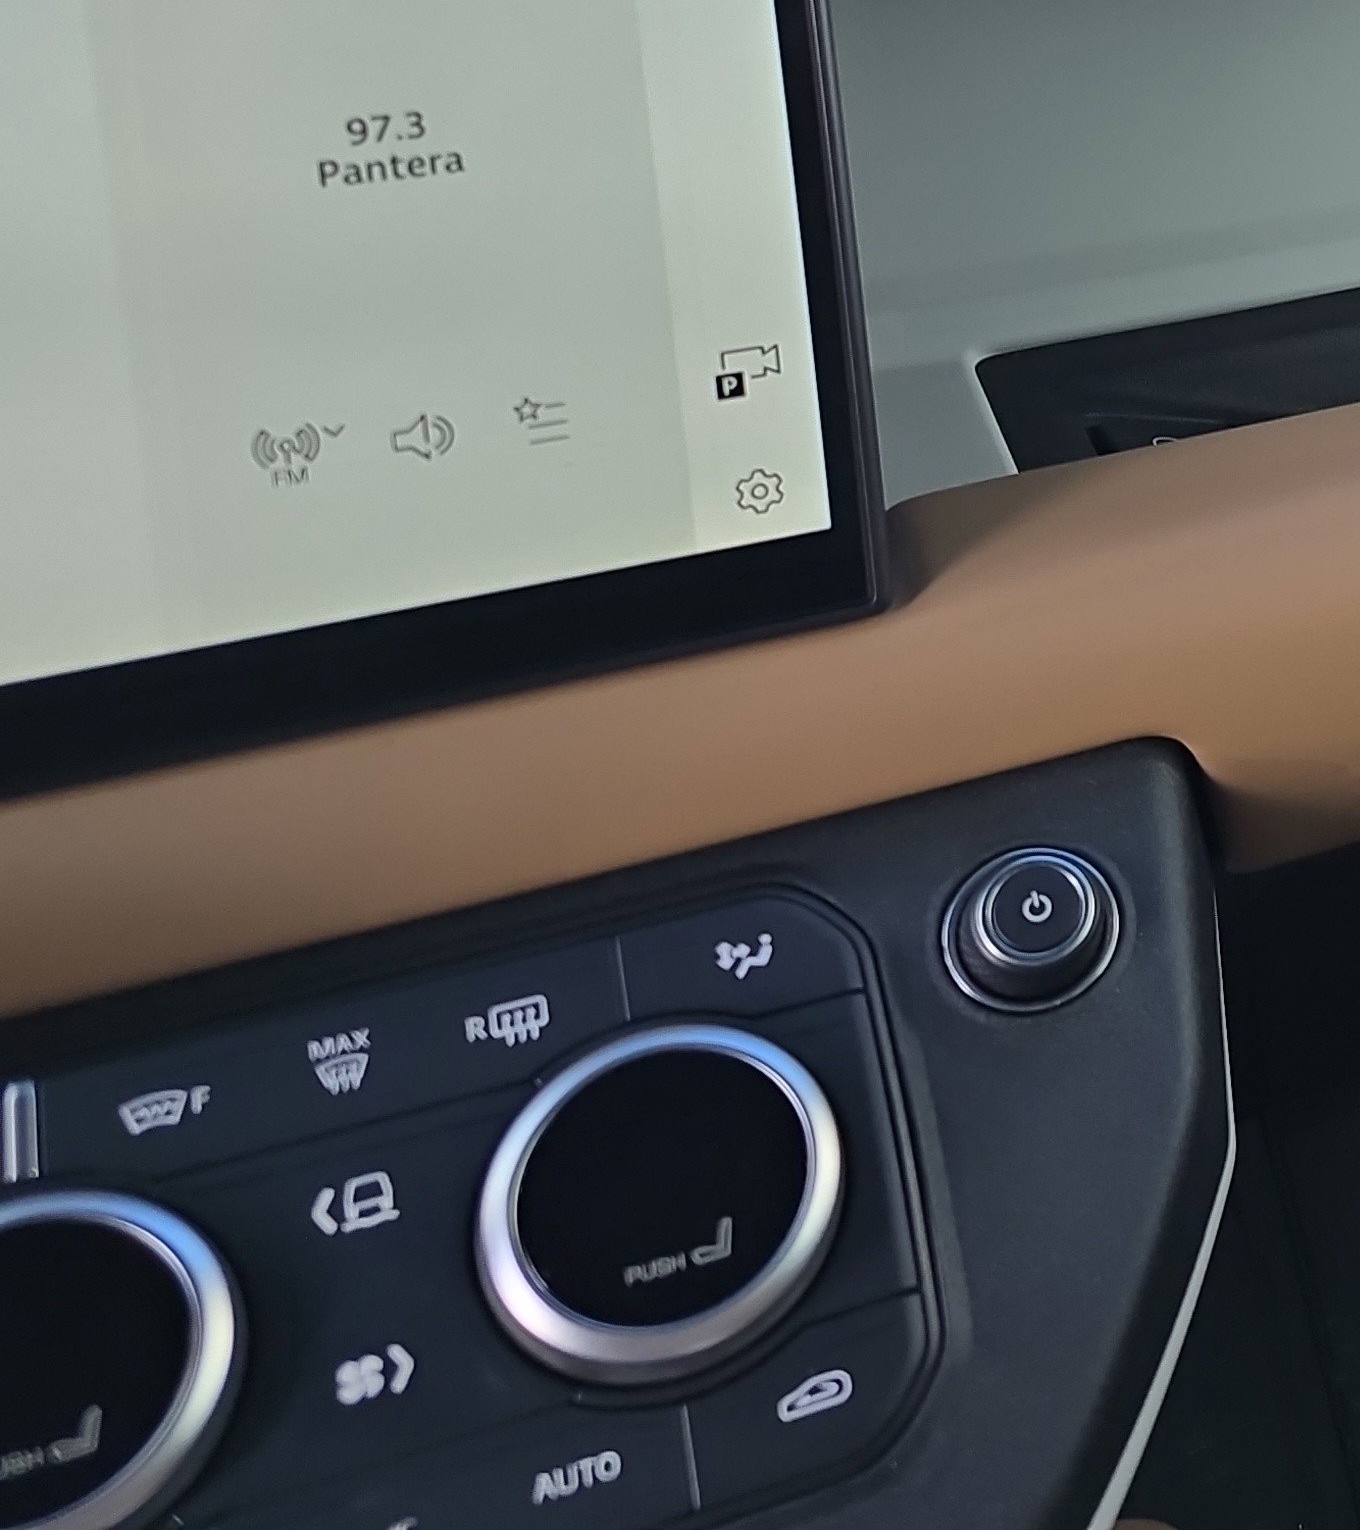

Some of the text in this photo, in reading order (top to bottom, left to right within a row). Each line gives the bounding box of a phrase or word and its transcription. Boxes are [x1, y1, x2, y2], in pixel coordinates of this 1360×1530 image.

[345, 111, 427, 147] 97.3
[318, 150, 466, 189] Pantera
[271, 466, 310, 488] FM
[306, 1027, 371, 1063] MAX
[464, 1016, 488, 1043] R
[190, 1085, 212, 1115] F
[623, 1251, 688, 1288] PUSH
[532, 1450, 622, 1506] AUTO
